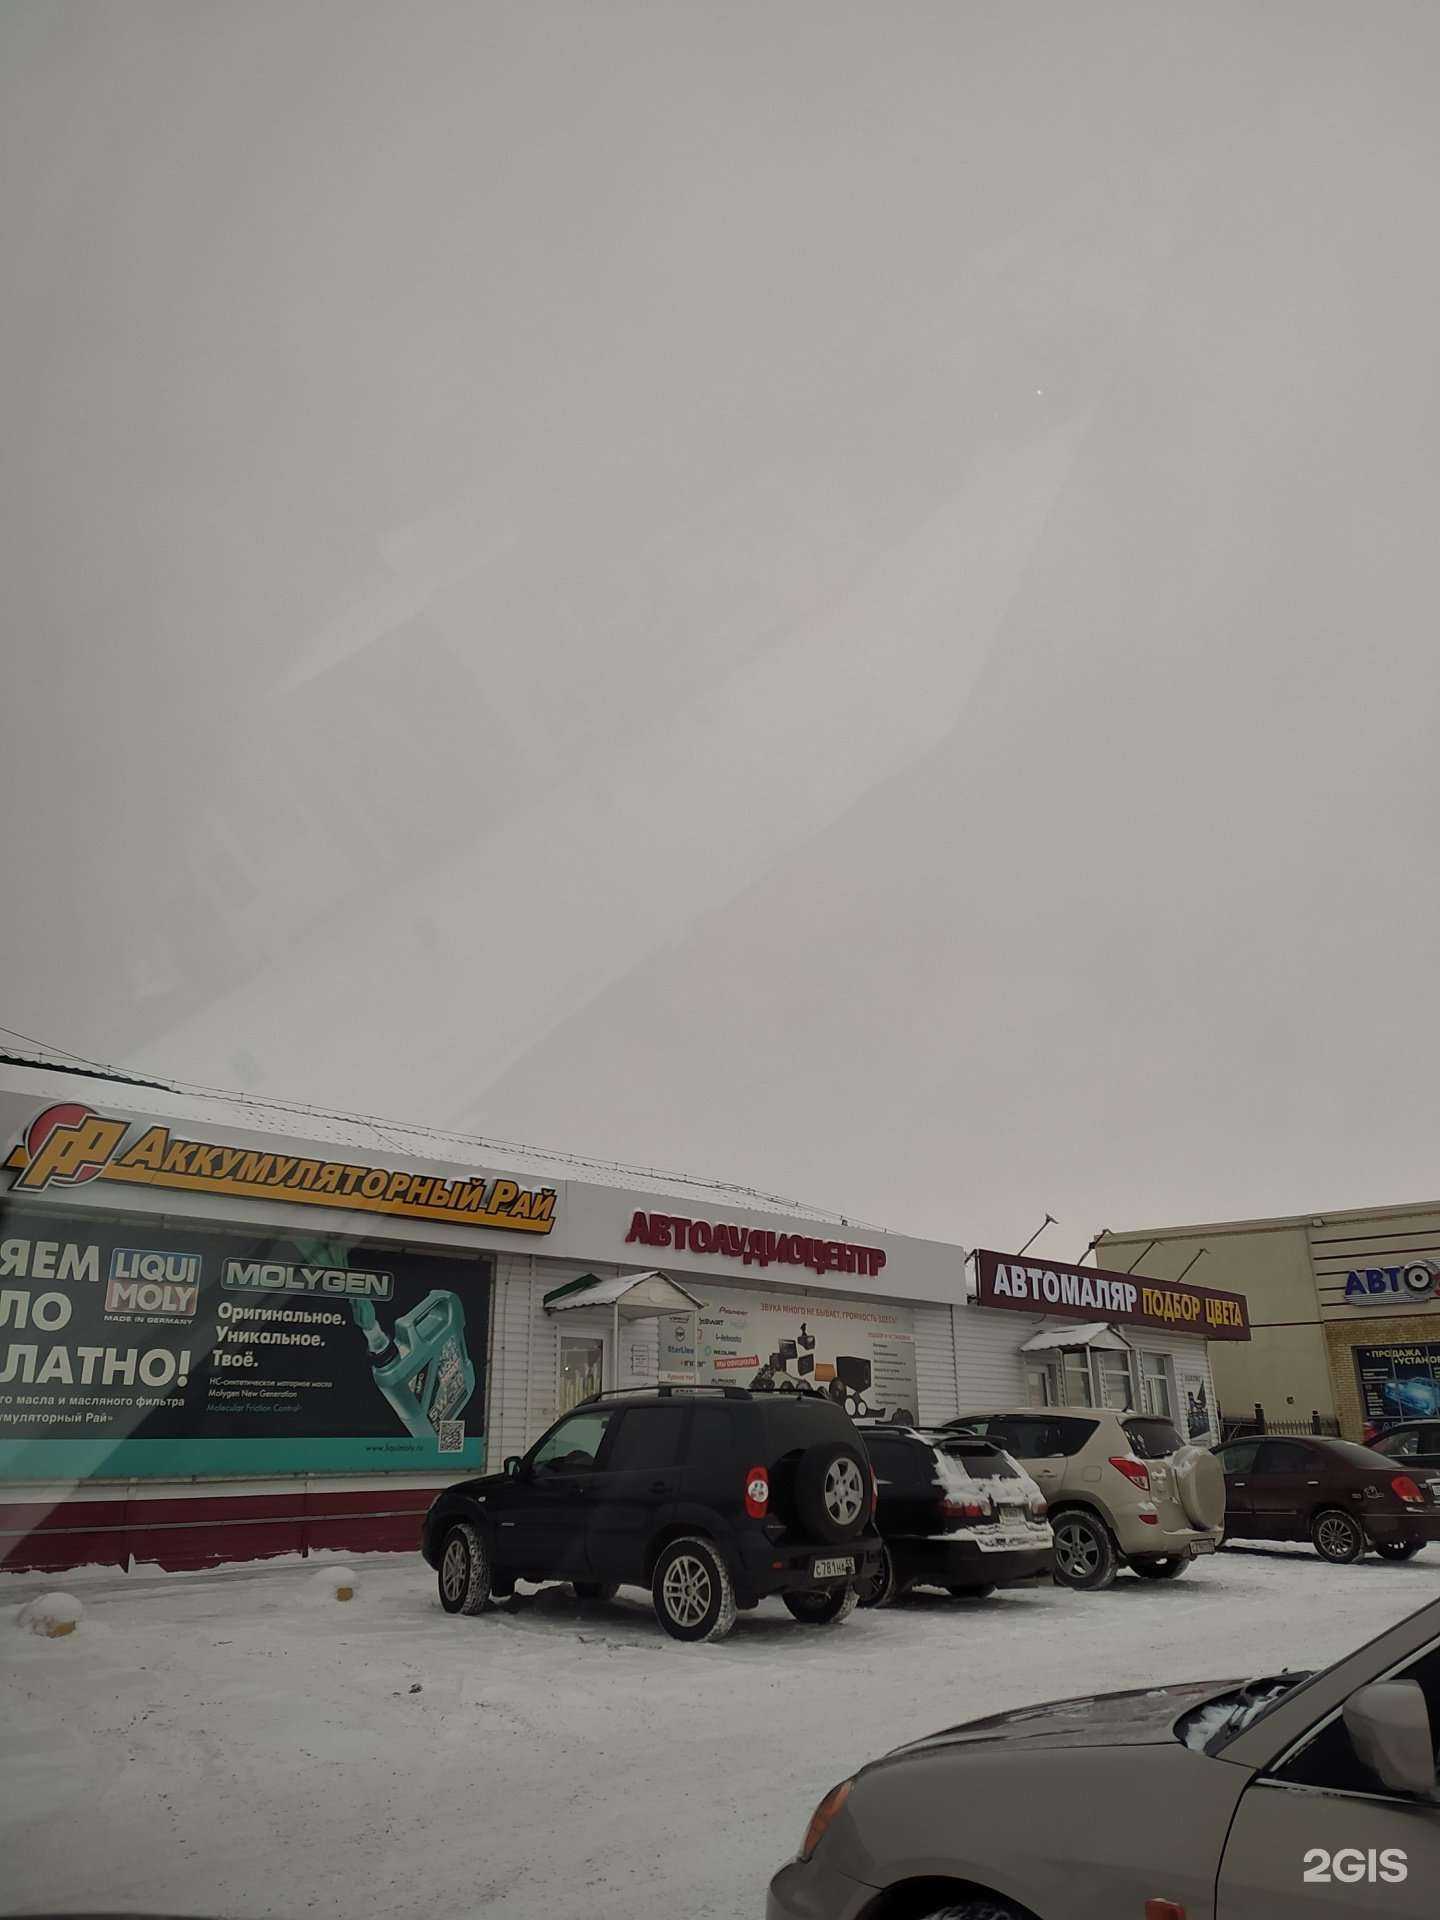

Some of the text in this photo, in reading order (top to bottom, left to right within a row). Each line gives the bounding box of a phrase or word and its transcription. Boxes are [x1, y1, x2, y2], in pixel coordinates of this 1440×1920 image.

[625, 1210, 887, 1276] АВТОАУДИОЦЕНТР
[116, 1252, 197, 1283] LIQUI
[226, 1262, 389, 1296] MOLYGEN
[111, 1283, 196, 1312] MOLY
[993, 1263, 1138, 1313] АВТОМАЛЯР
[104, 1315, 132, 1323] MADE
[146, 1317, 193, 1325] GERMANY
[218, 1302, 346, 1326] Оригинальное.
[1142, 1287, 1244, 1328] ПОДБОР ЦВЕТА
[215, 1325, 326, 1347] Уникальное.
[0, 1344, 191, 1388] ЛАТНО!
[212, 1349, 258, 1368] Твоё.
[1371, 1348, 1421, 1358] ПРОДАЖА
[16, 1396, 55, 1406] масла
[58, 1397, 66, 1406] и
[69, 1397, 133, 1407] масляного
[135, 1397, 185, 1409] фильтра
[208, 1389, 298, 1399] Molygen New Generation
